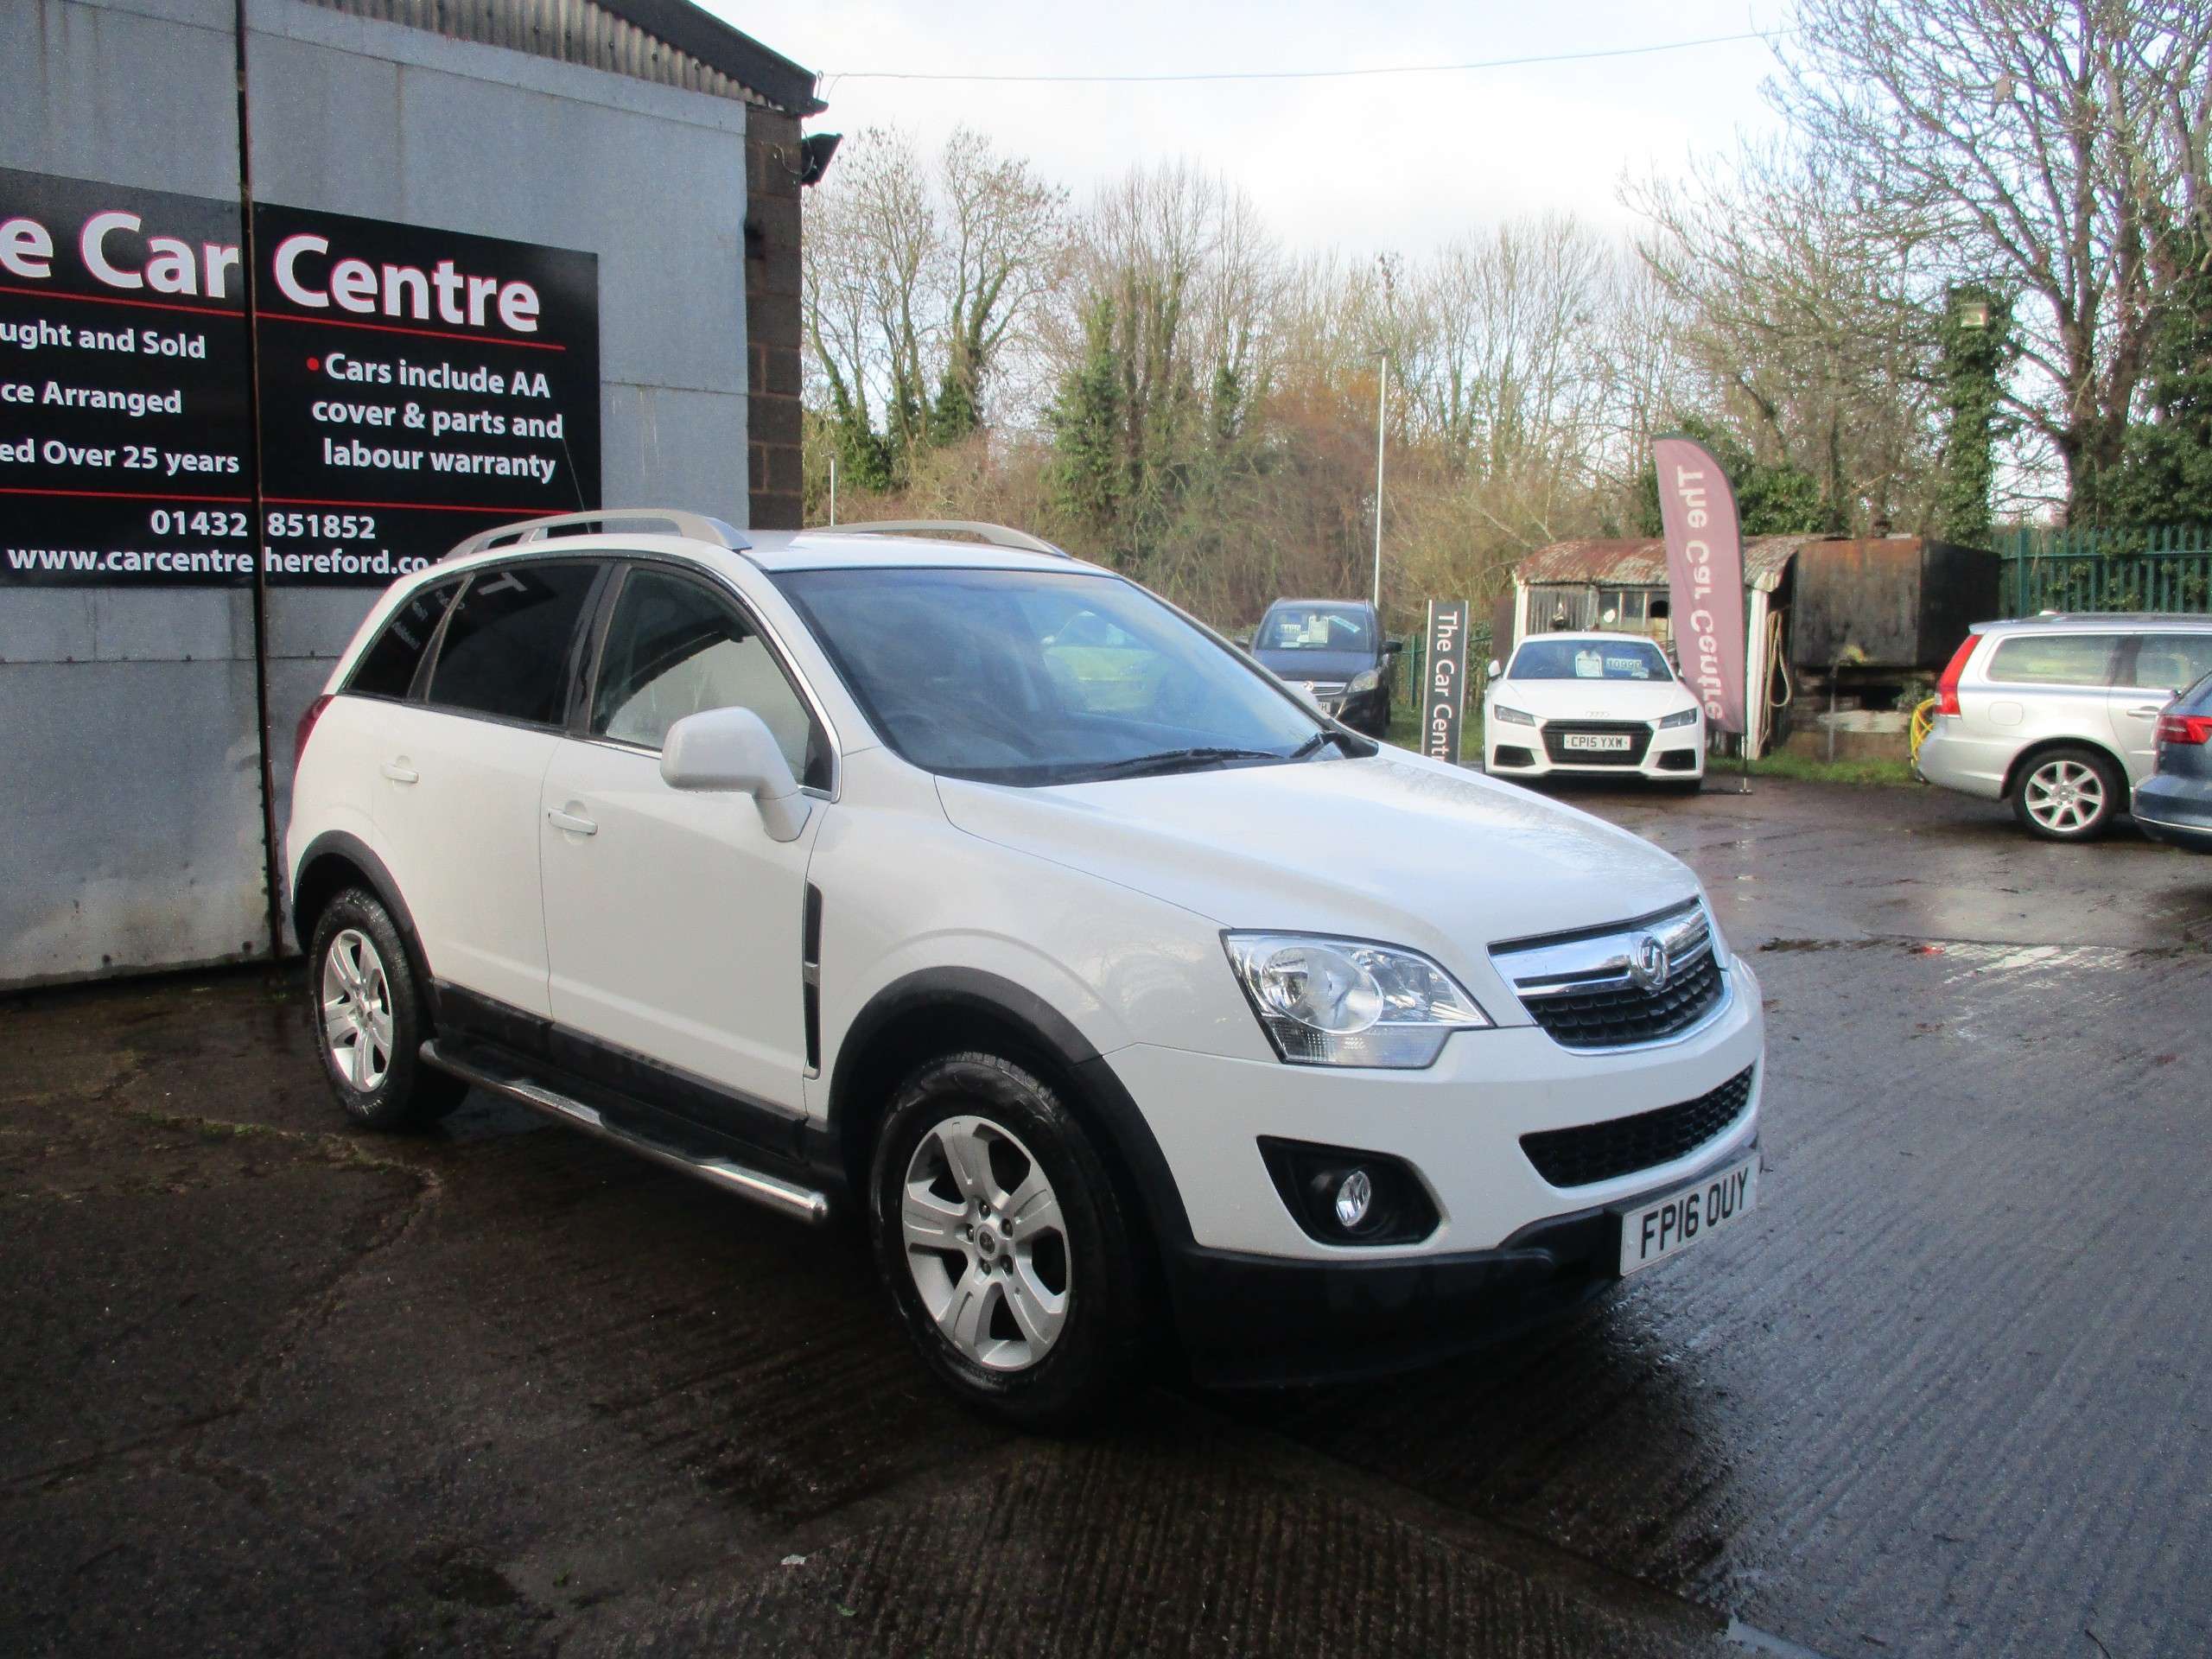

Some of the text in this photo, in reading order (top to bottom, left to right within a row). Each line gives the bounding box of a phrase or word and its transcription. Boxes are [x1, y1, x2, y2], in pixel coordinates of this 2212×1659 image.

[79, 209, 240, 298] Car
[273, 232, 541, 334] Centre
[79, 327, 136, 353] and
[143, 331, 206, 359] Sold
[325, 352, 551, 398] Cars include AA
[42, 380, 182, 416] Arranged
[312, 400, 563, 439] cover & parts and
[42, 440, 117, 467] Over
[123, 445, 158, 470] 25
[164, 451, 239, 477] years
[324, 437, 556, 484] labour warranty
[150, 508, 376, 540] 01432 851852
[1436, 611, 1459, 652] The
[1434, 659, 1455, 696] Car
[1571, 736, 1598, 747] CP15
[1640, 1166, 1749, 1260] FP16 OUY
